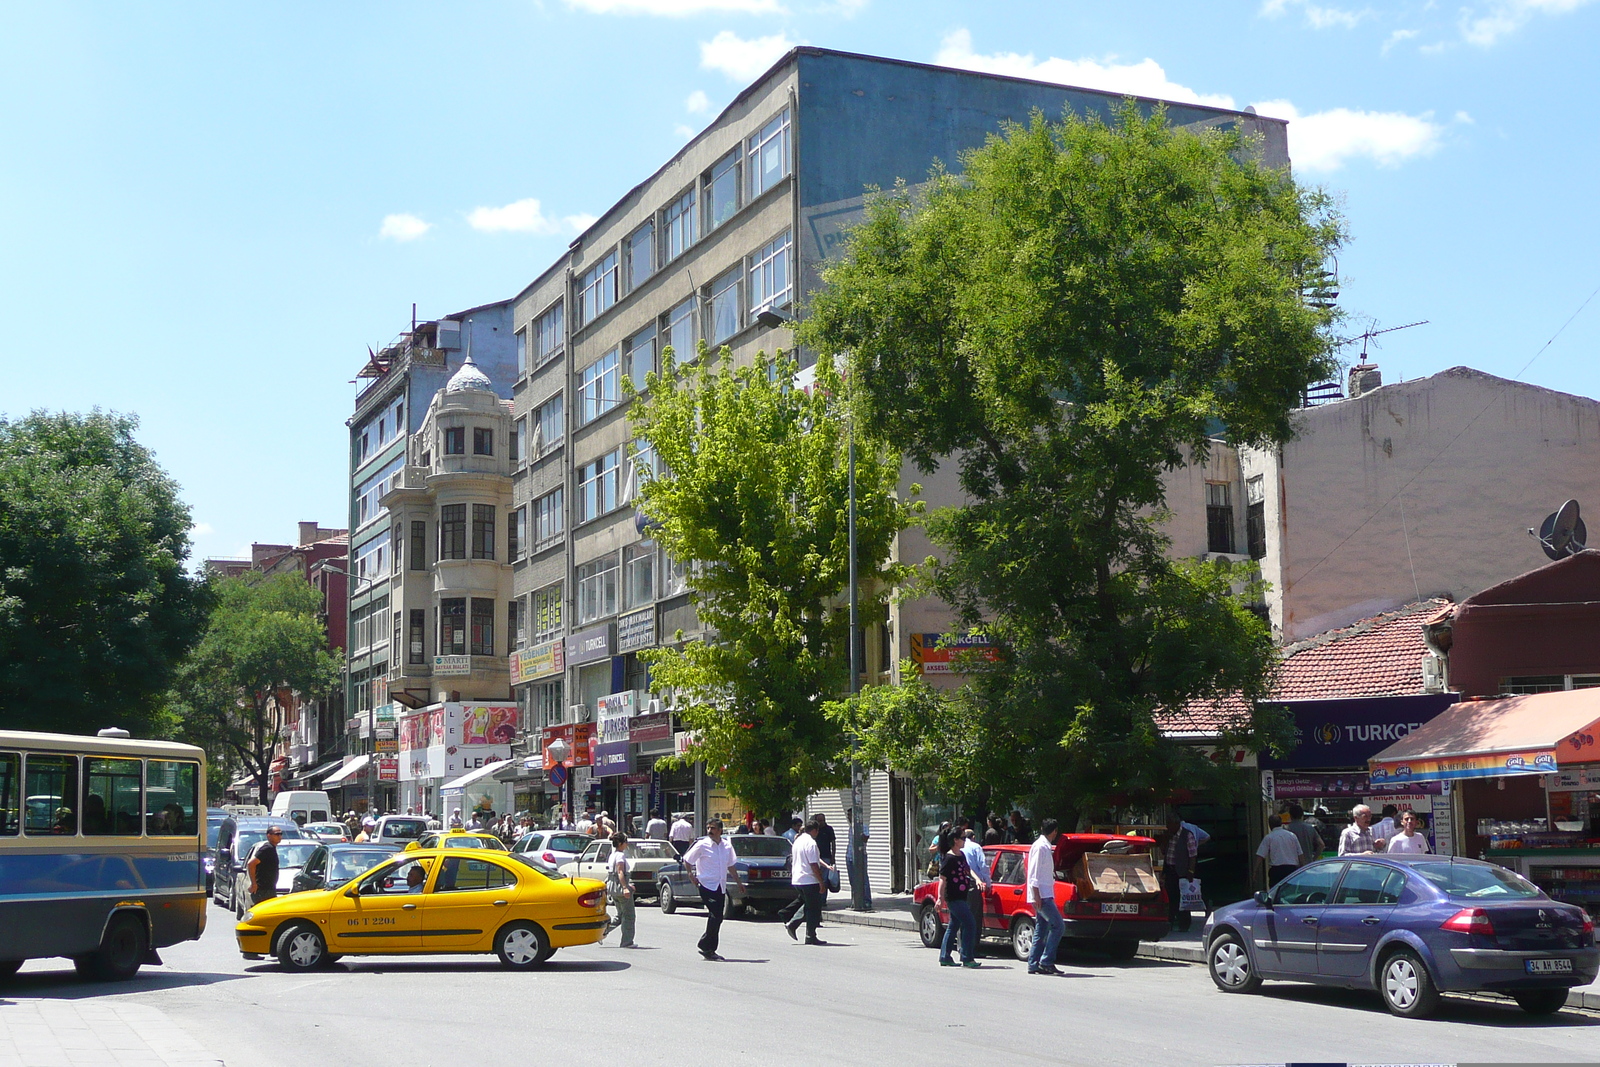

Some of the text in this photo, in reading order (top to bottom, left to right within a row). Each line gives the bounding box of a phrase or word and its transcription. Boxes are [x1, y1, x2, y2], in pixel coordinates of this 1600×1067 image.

[585, 636, 606, 651] TURKCELL
[1345, 722, 1423, 742] TURKCE
[608, 753, 626, 764] TURKCELL
[1437, 761, 1477, 771] KISMET BÜFE
[347, 917, 395, 926] 06 T 2204
[1530, 960, 1571, 971] 34 AH 8544
